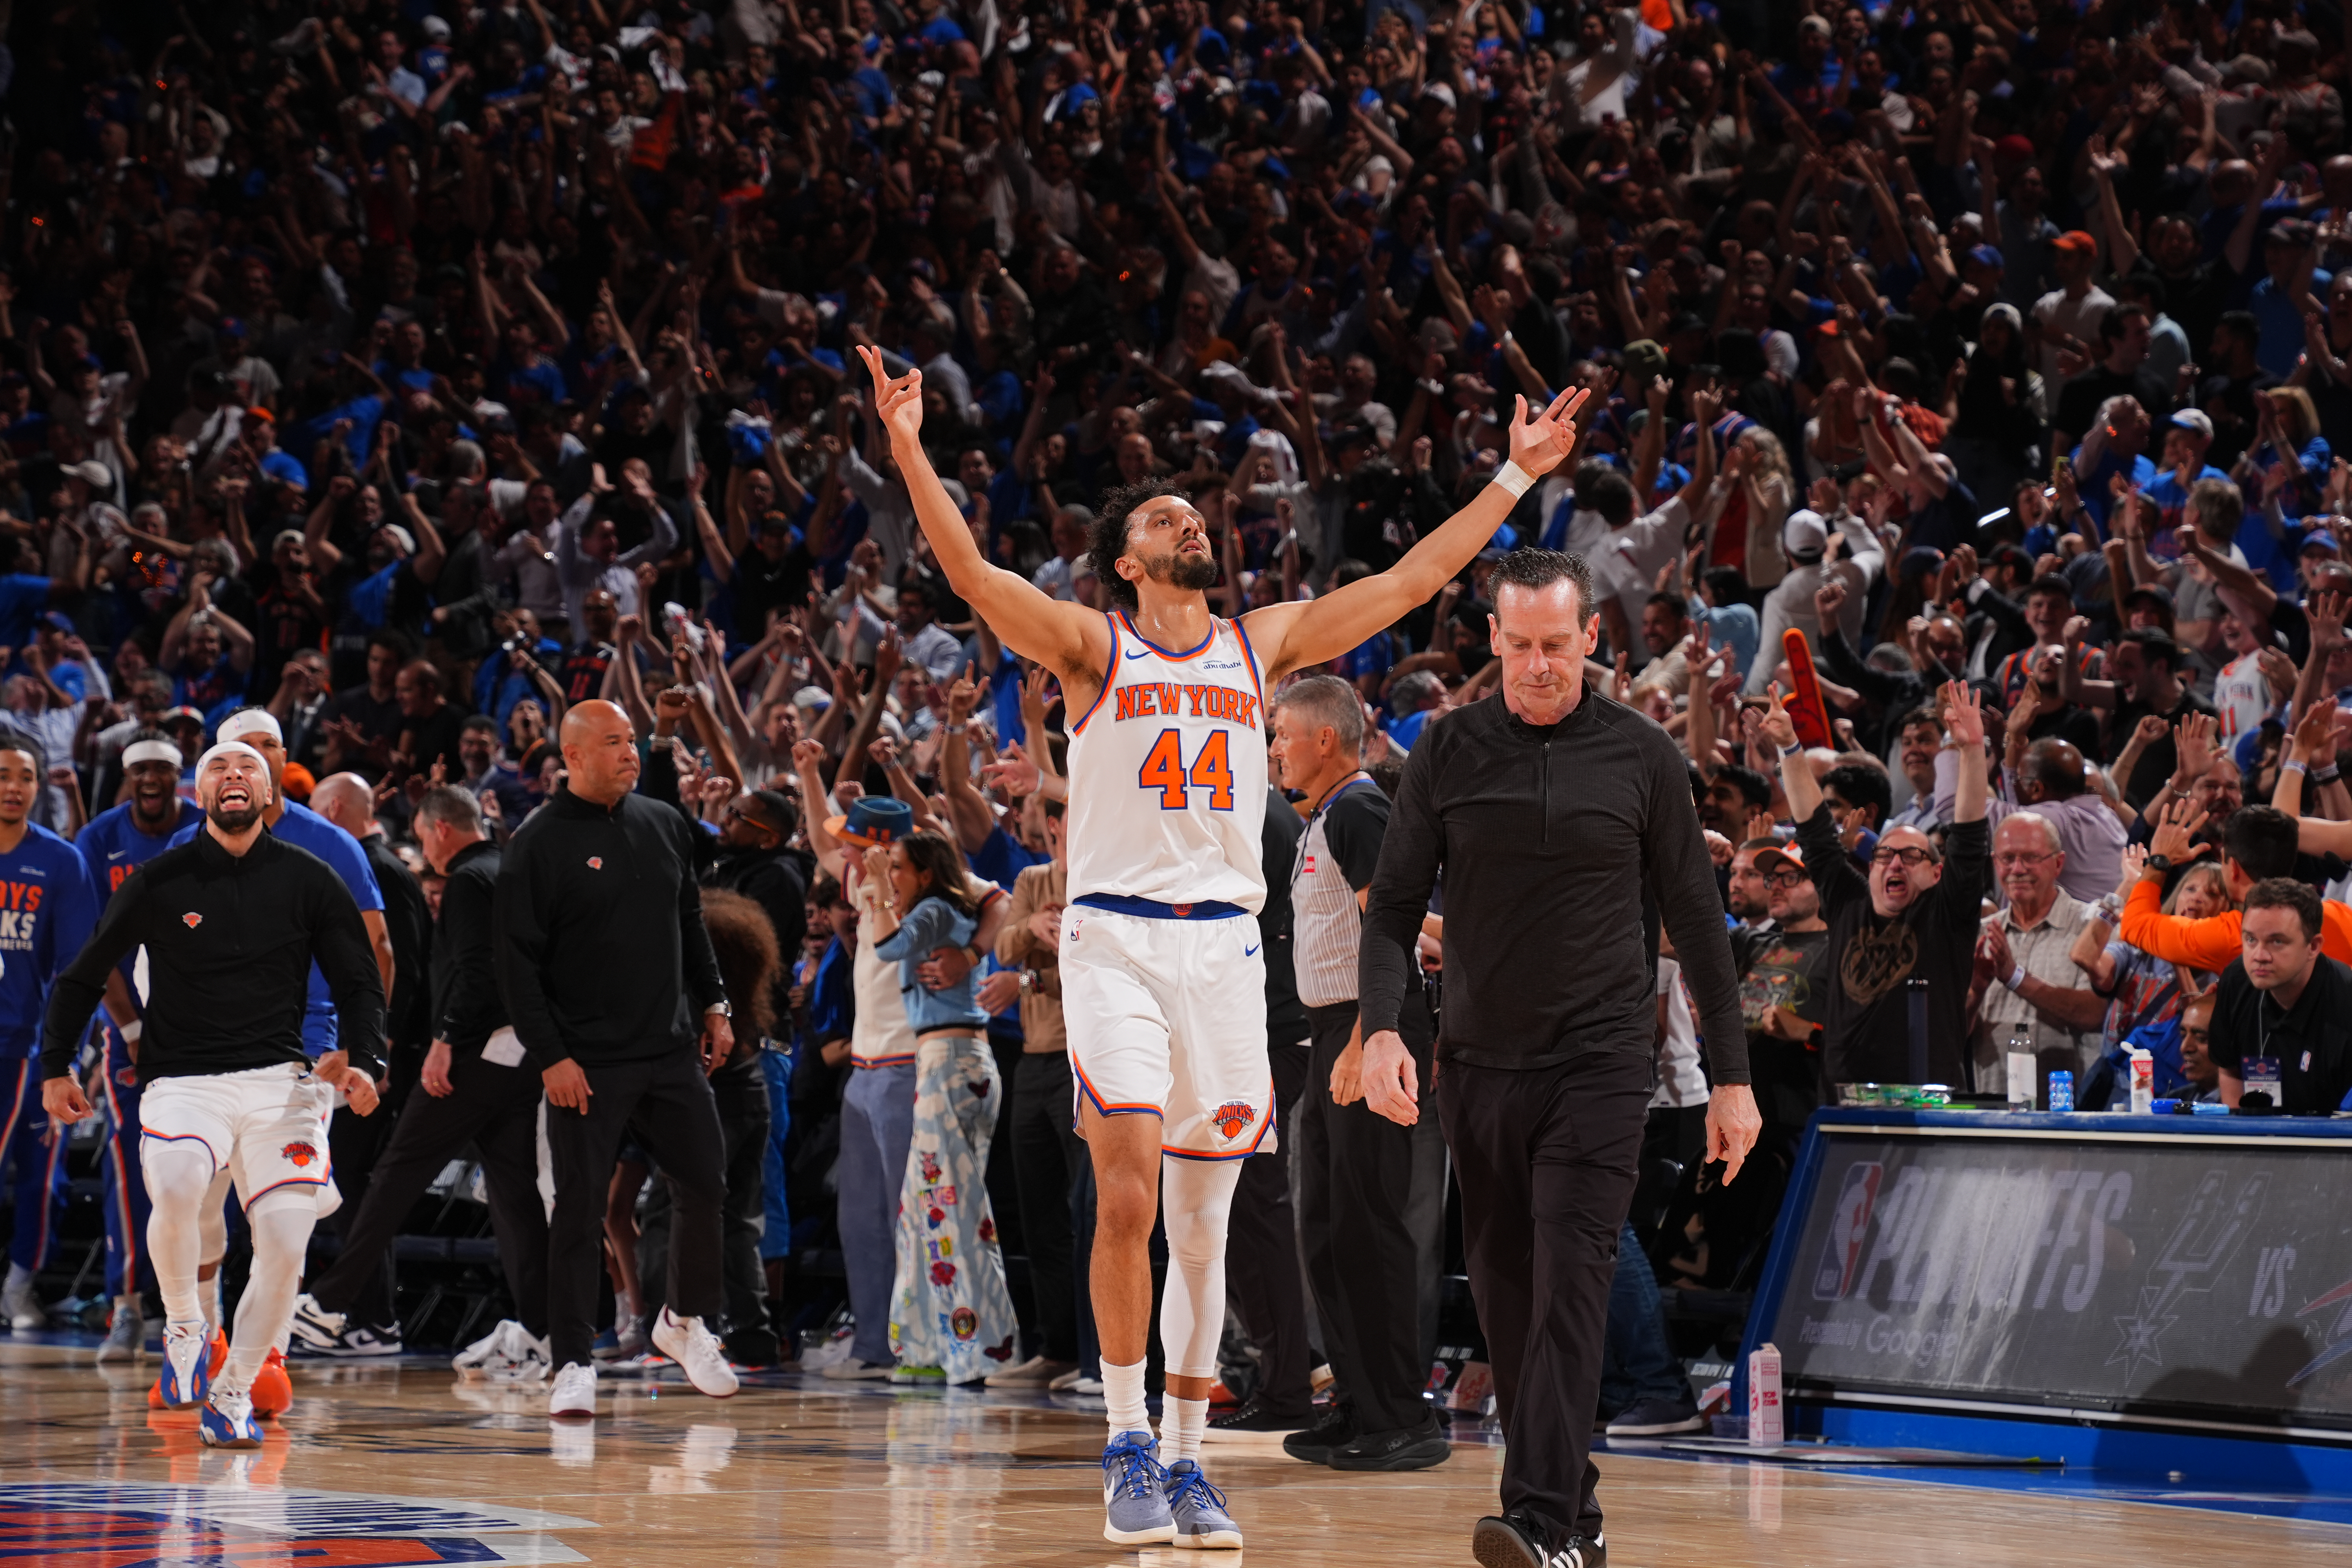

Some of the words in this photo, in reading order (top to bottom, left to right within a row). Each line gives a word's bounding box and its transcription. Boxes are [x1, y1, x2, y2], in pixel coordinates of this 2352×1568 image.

[1219, 660, 1241, 669] dhabi
[1115, 682, 1181, 723] NEW
[1183, 683, 1257, 732] YORK
[1138, 728, 1234, 811] 44
[1212, 1104, 1254, 1122] KNICKS
[1854, 1165, 2133, 1313] PLFFS
[2248, 1244, 2297, 1318] VS
[1867, 1314, 1958, 1369] Google
